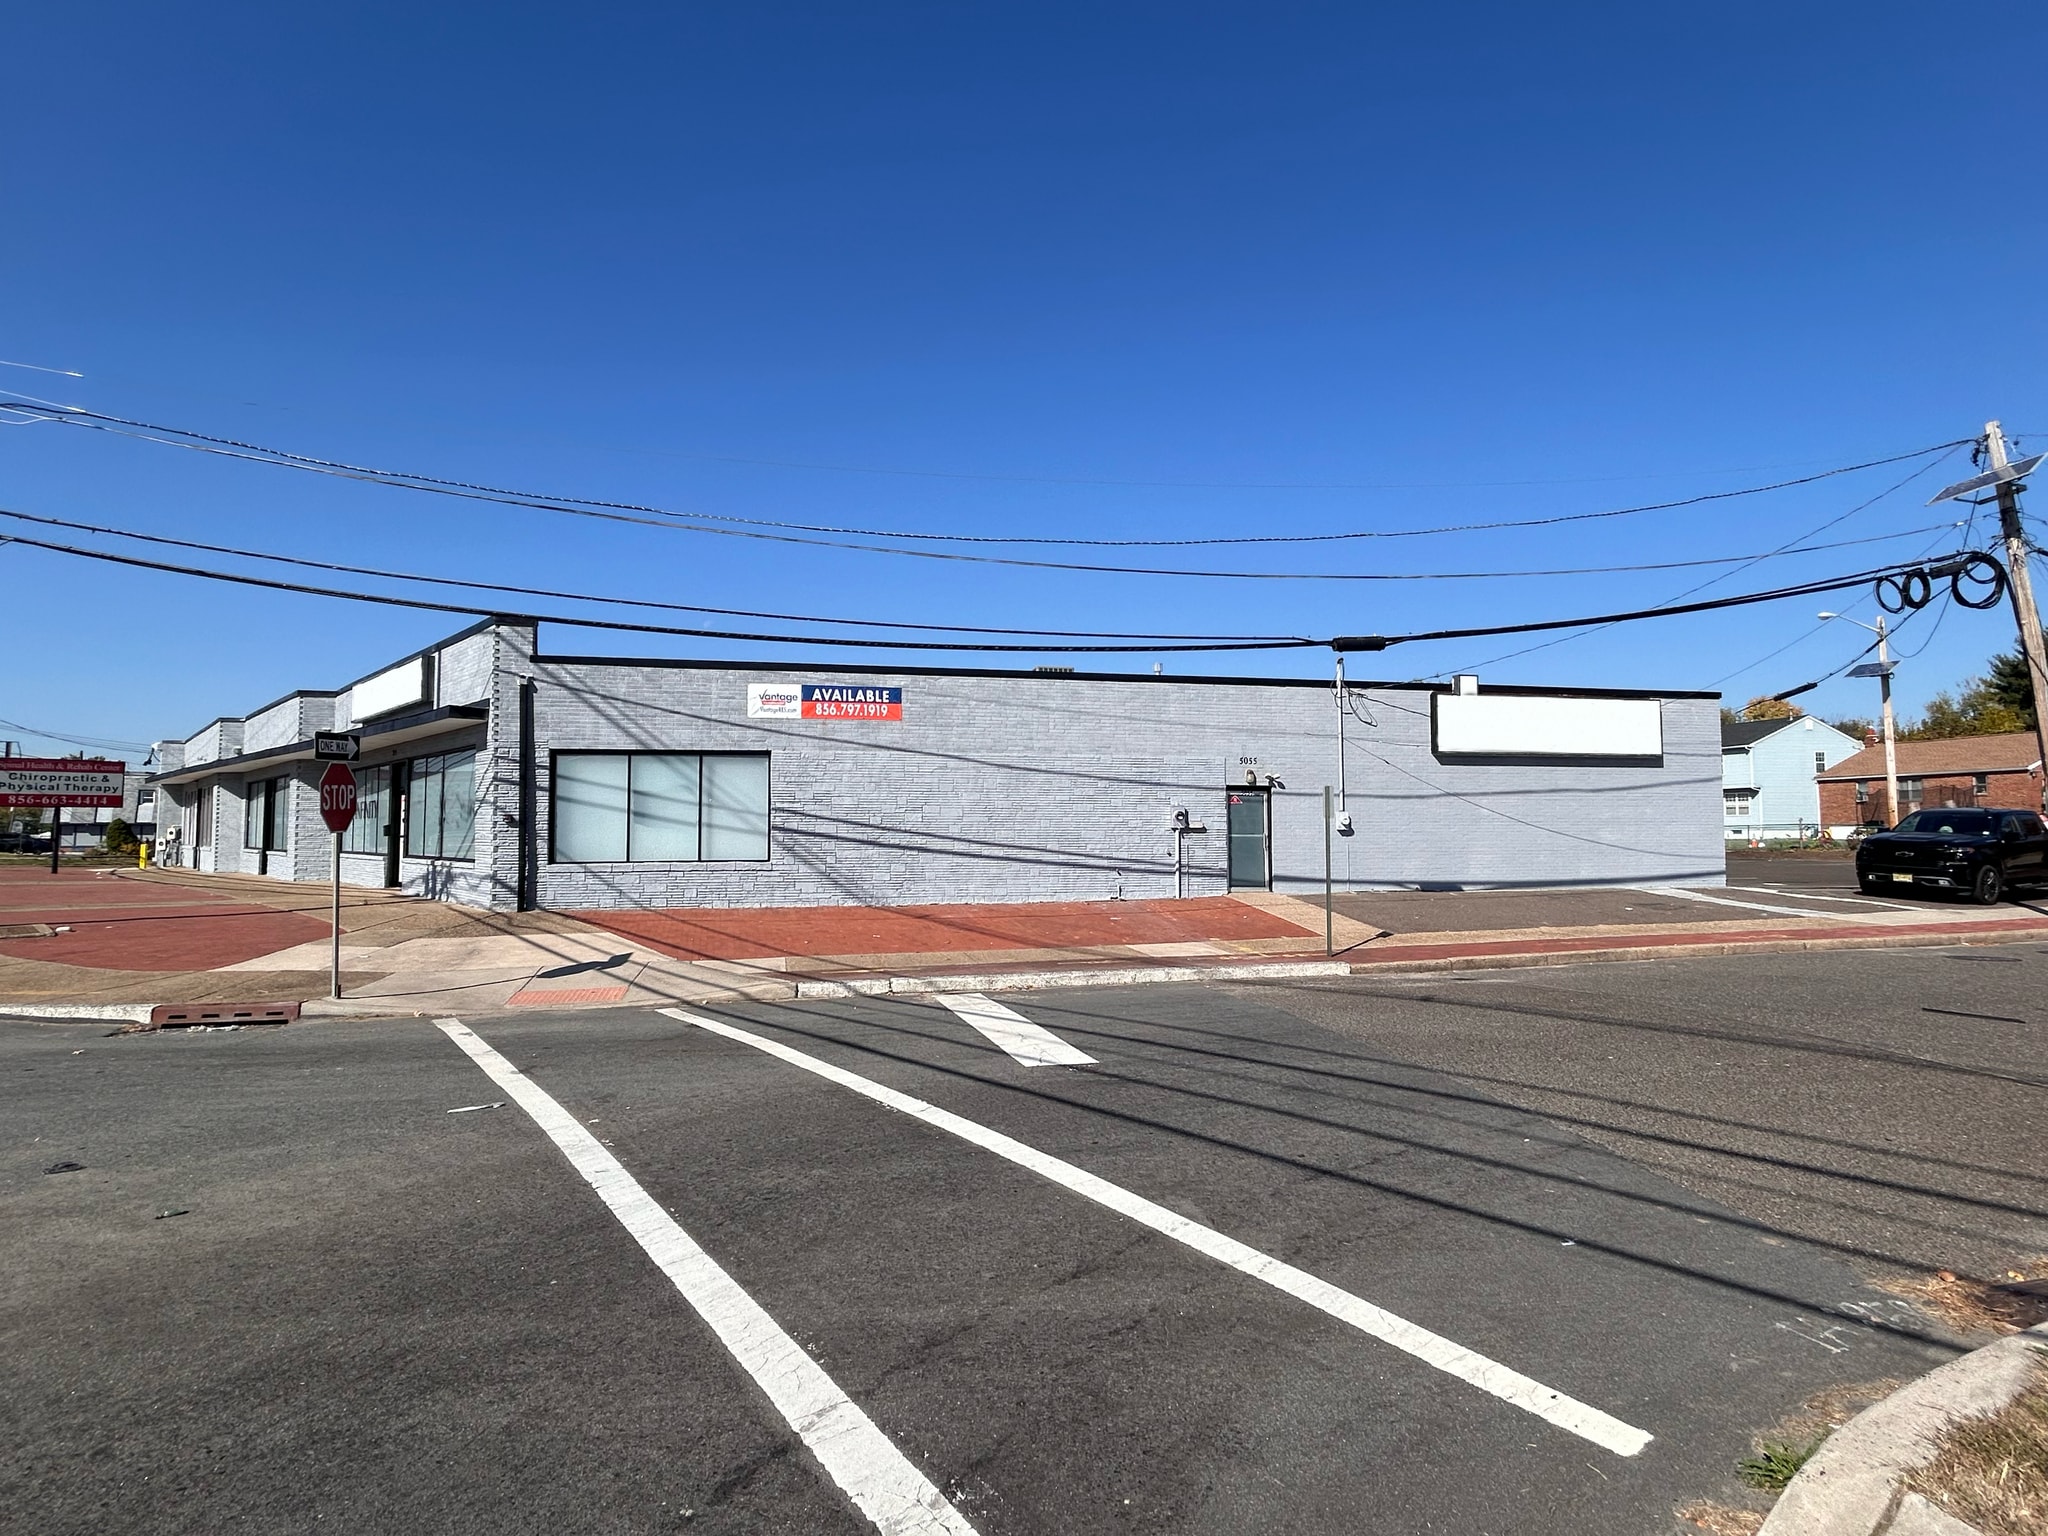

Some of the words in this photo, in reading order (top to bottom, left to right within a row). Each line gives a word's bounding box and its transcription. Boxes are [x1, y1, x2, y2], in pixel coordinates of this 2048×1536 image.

[759, 689, 798, 703] Vantage
[812, 688, 890, 703] AVAILABLE
[815, 703, 888, 717] 856.797.1919
[320, 740, 334, 752] ONE
[336, 742, 348, 753] WAY
[27, 762, 55, 770] Health
[56, 762, 64, 770] &
[94, 763, 120, 771] Center
[1239, 757, 1258, 765] 5055
[9, 772, 98, 783] Chiropractic
[101, 775, 110, 783] &
[0, 782, 60, 792] Physical
[64, 783, 119, 794] Therapy
[8, 795, 107, 804] 856-663-4414
[323, 784, 355, 810] STOP
